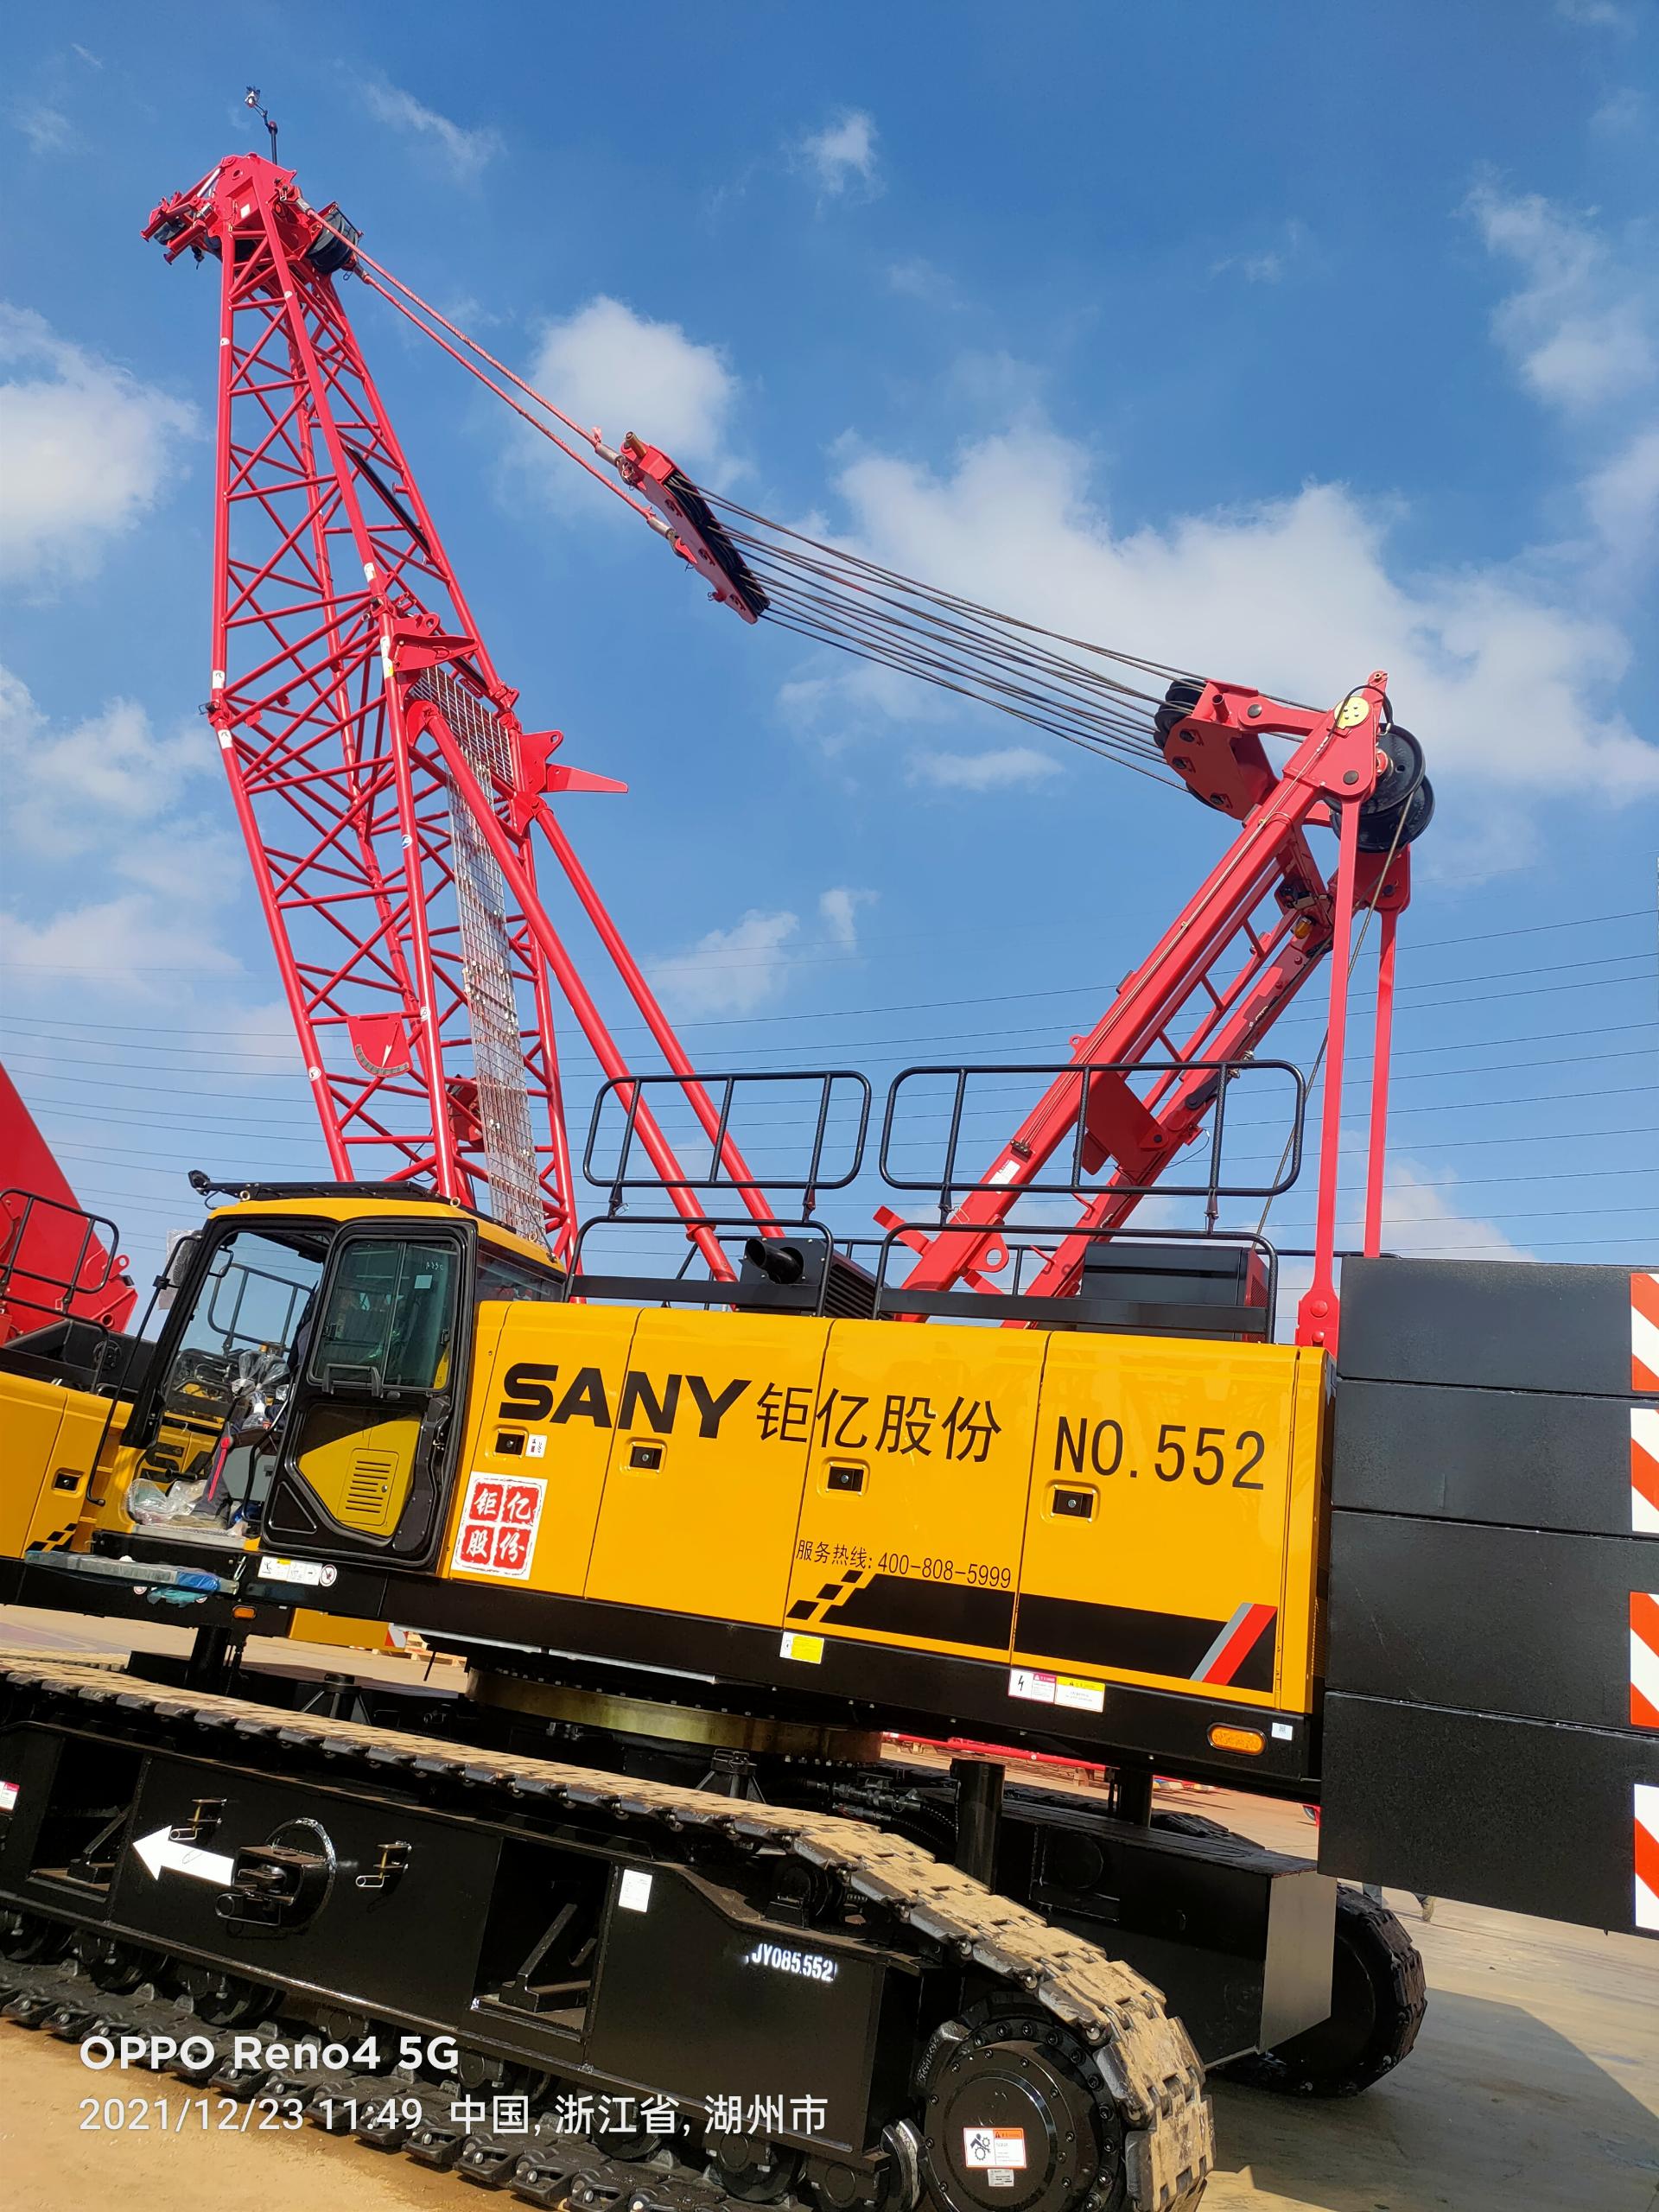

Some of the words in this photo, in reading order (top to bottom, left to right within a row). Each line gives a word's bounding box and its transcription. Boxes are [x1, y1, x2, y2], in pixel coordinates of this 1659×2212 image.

[498, 1362, 752, 1440] SANY
[756, 1382, 1002, 1463] 钜亿股份
[1053, 1415, 1265, 1491] NO.552
[877, 1552, 1012, 1589] 400-808-5999
